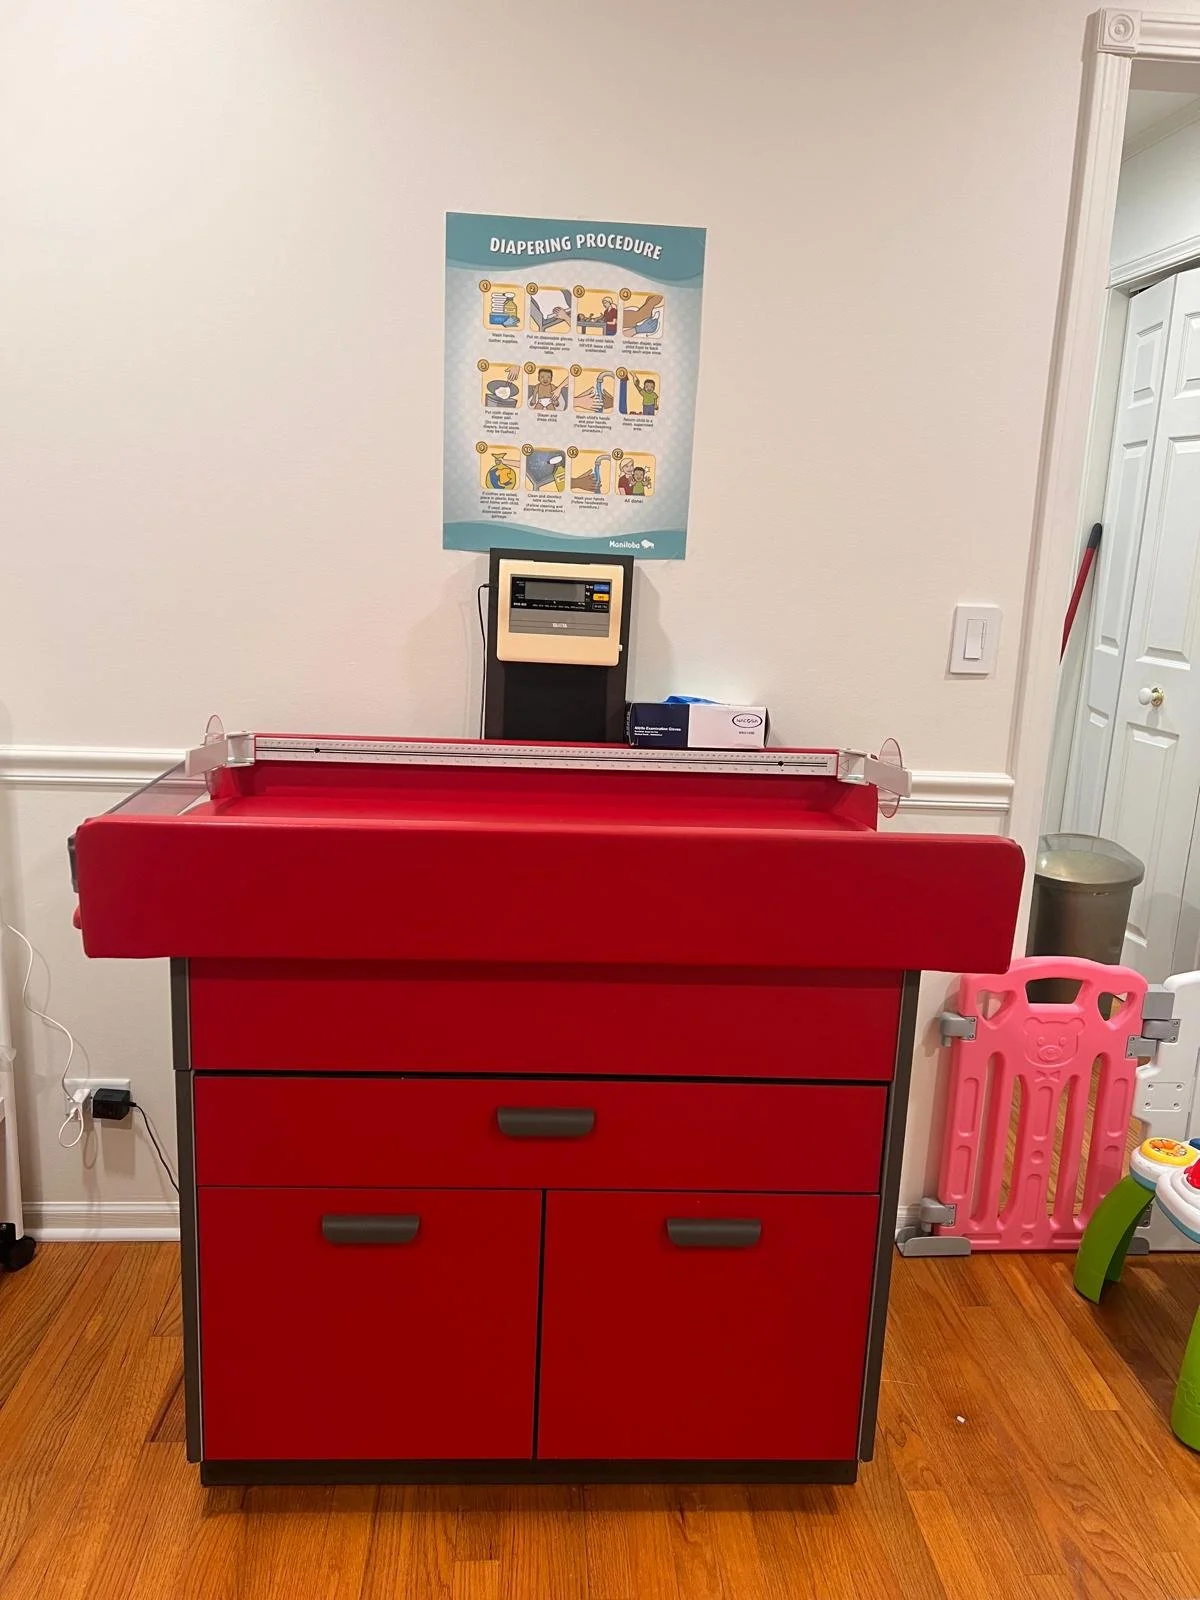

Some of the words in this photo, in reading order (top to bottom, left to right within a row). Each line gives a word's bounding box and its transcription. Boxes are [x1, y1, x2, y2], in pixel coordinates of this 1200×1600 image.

[490, 236, 572, 254] DIAPERING
[576, 234, 662, 260] PROCEDURE
[610, 540, 640, 548] Manitoba
